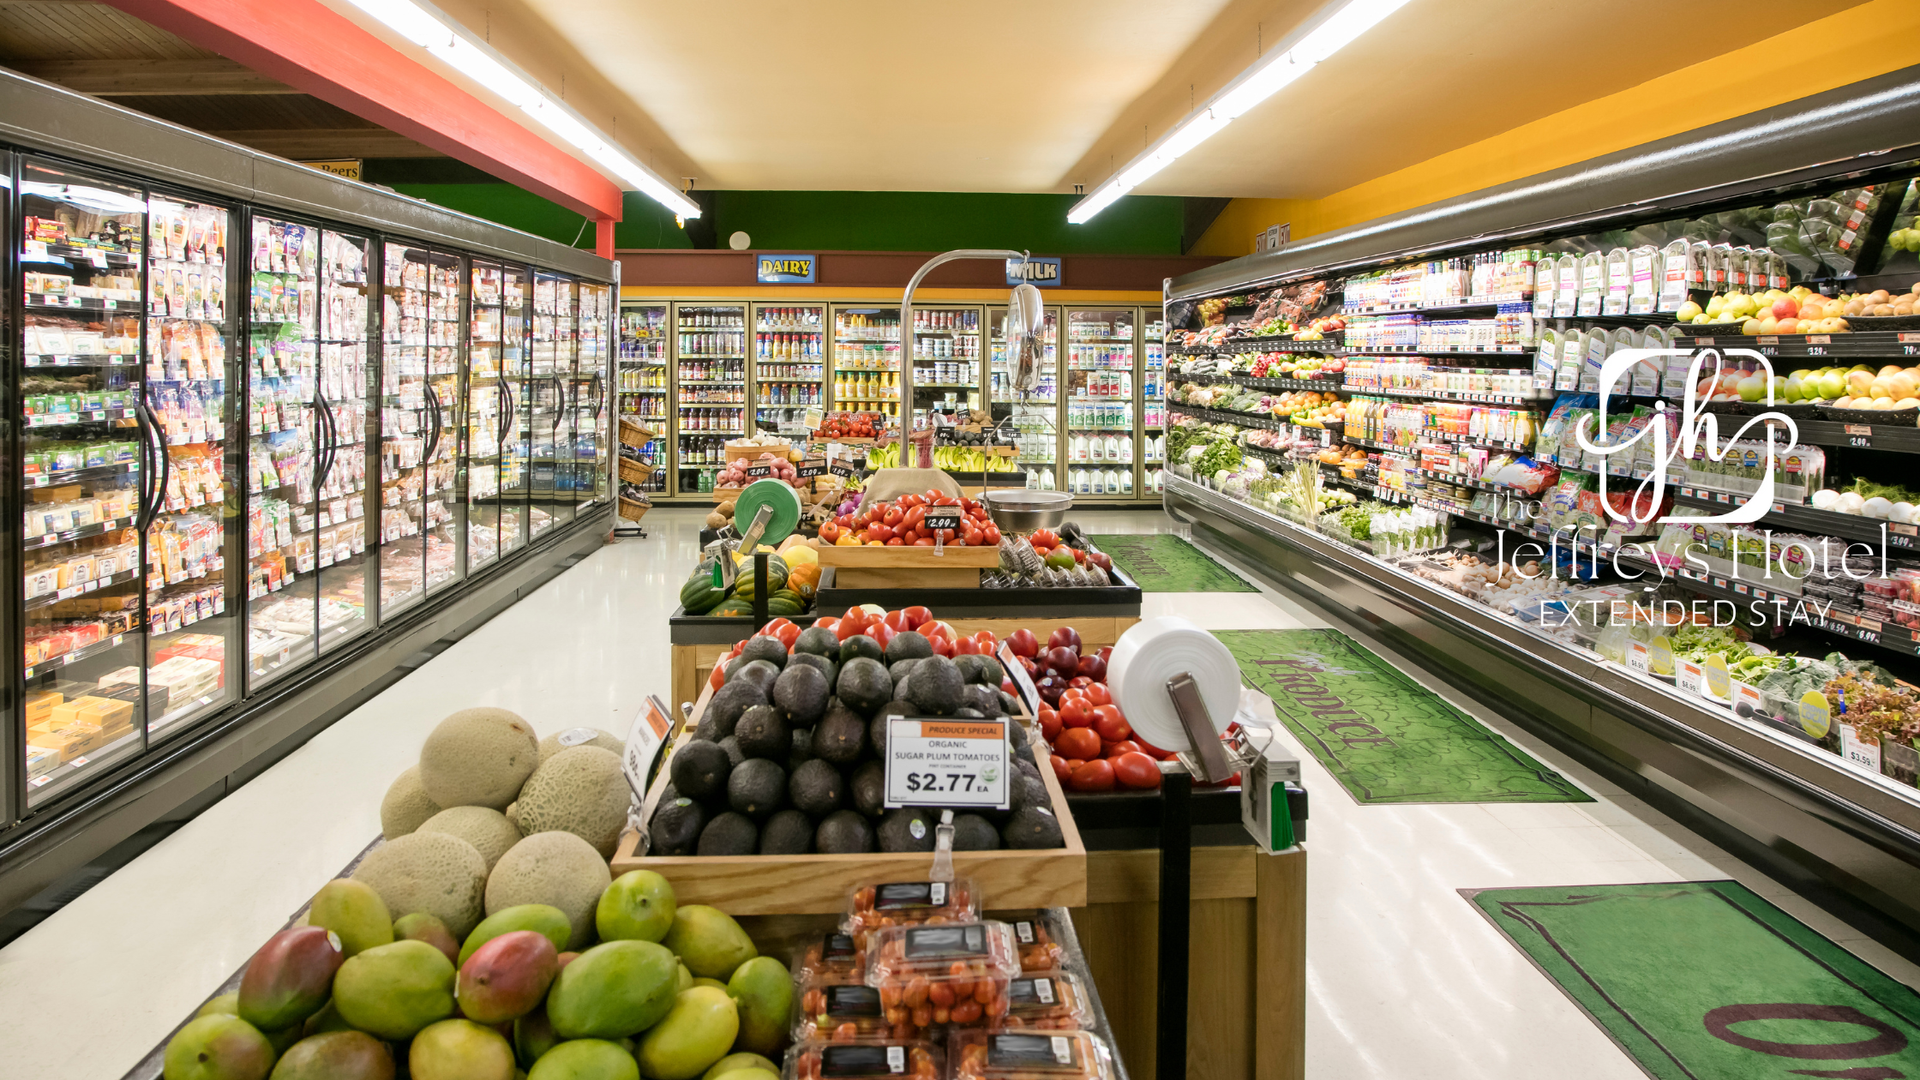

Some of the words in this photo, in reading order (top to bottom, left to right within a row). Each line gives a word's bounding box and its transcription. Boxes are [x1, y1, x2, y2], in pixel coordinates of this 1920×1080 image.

[761, 260, 811, 277] DAIRY
[1000, 262, 1057, 280] MILK
[1255, 658, 1400, 750] PRODUCE
[1802, 701, 1828, 717] GROWN
[1801, 709, 1829, 727] LOCAL
[929, 726, 965, 734] PRODUCE
[967, 727, 997, 735] SPECIAL
[928, 740, 968, 749] ORGANIC
[895, 752, 924, 760] SUGAR
[926, 752, 951, 761] PLUM
[953, 753, 1000, 762] TOMATOES
[906, 772, 977, 793] $2.77
[977, 785, 989, 793] EA
